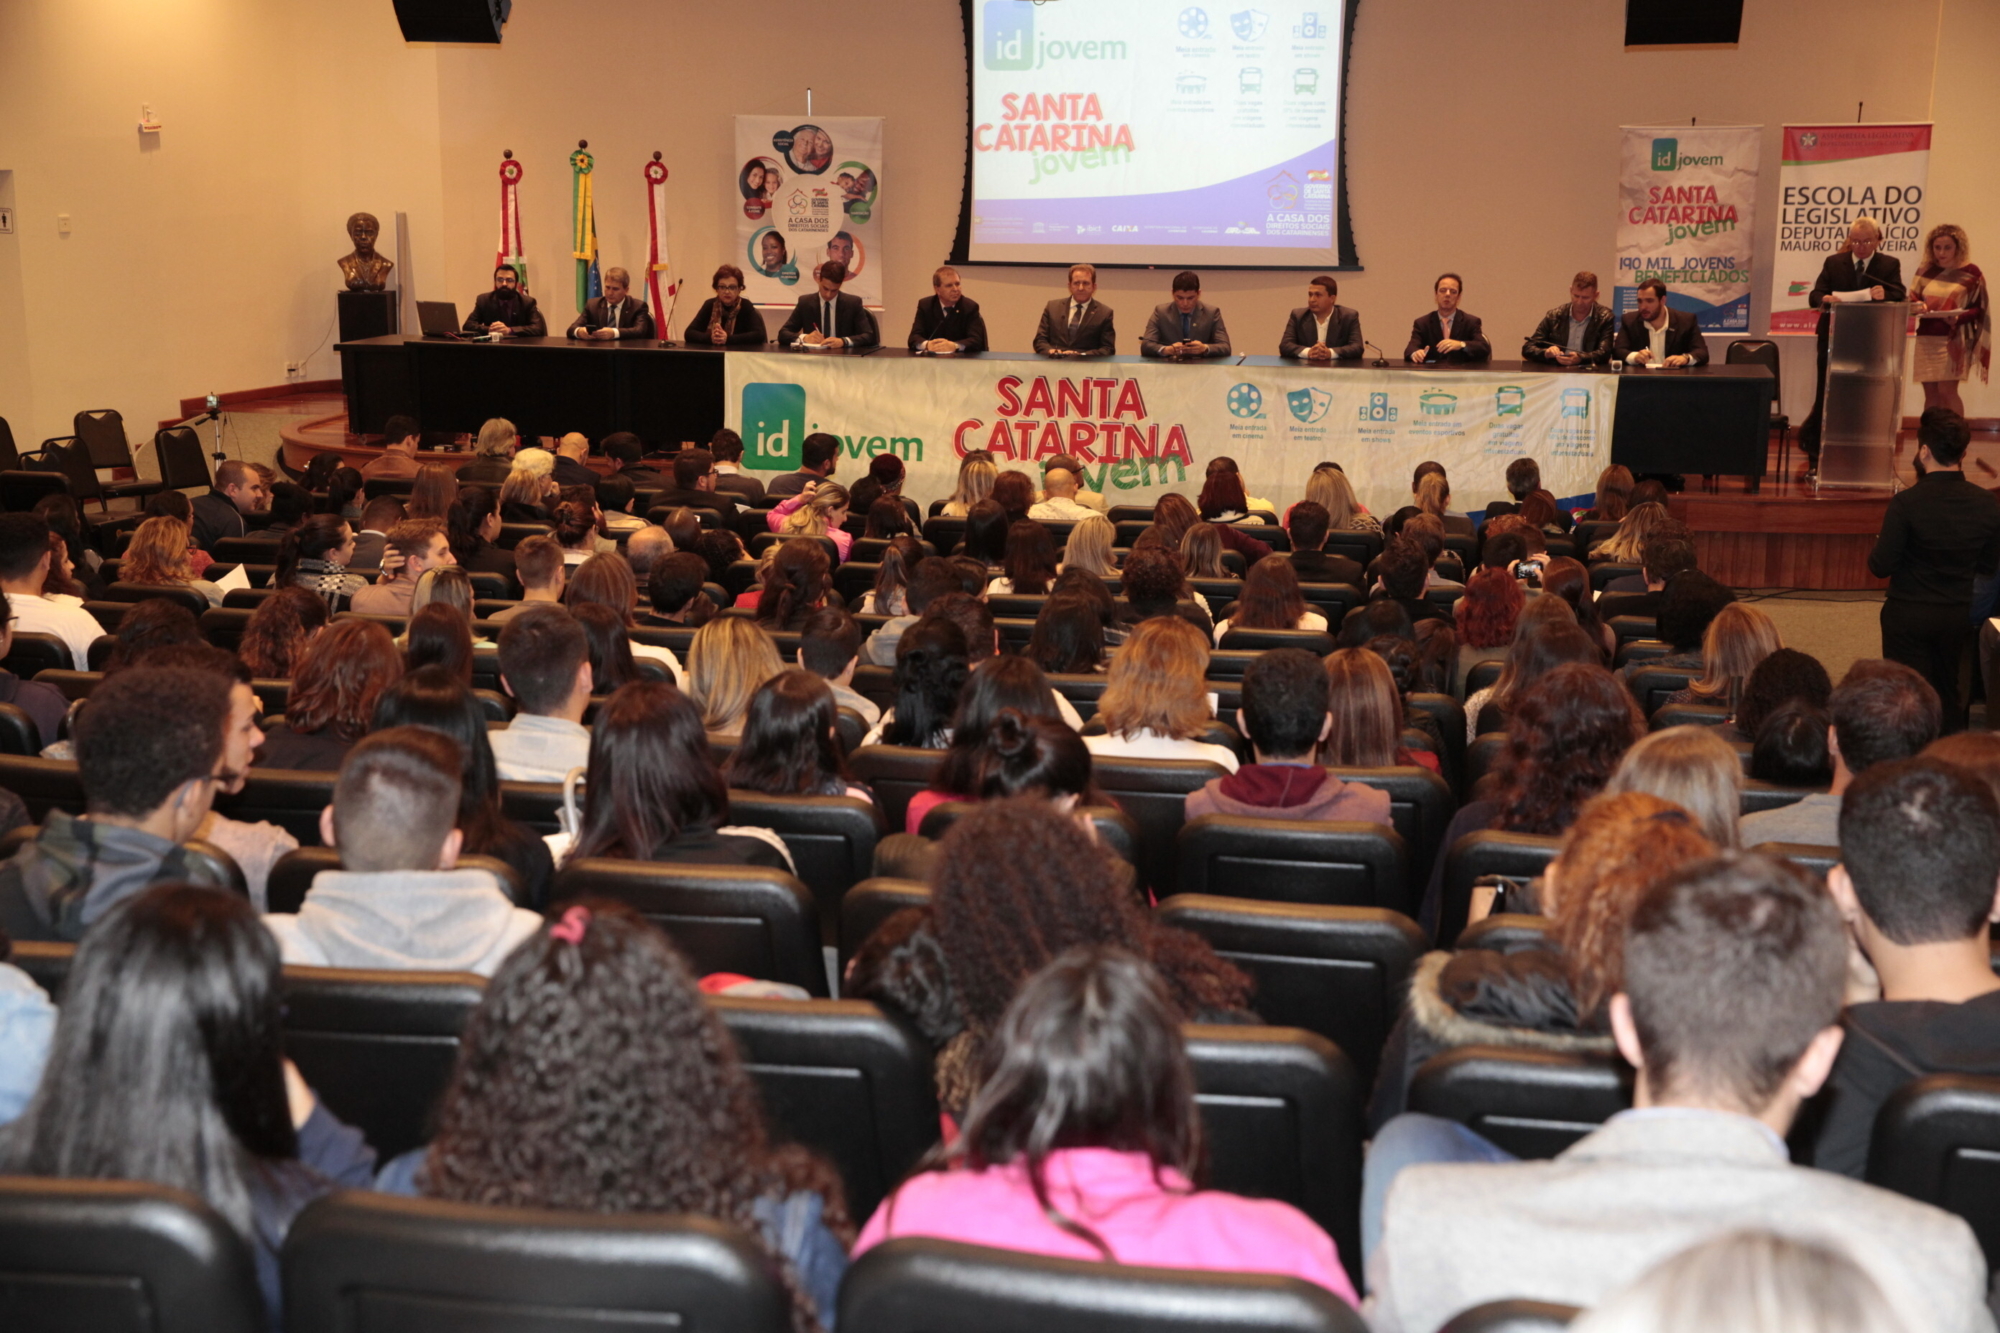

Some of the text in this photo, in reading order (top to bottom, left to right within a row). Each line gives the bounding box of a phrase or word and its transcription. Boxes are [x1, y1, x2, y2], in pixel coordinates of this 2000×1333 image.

[996, 29, 1126, 70] id jovem
[1001, 92, 1104, 122] SANTA
[974, 122, 1136, 152] CATARINA
[1028, 143, 1132, 185] jovem
[1657, 151, 1724, 170] id jovem
[1648, 185, 1718, 204] SANTA
[1783, 185, 1922, 205] ESCOLA DO
[1266, 213, 1330, 223] A CASA DOS
[1628, 204, 1739, 225] CATARINA
[1782, 207, 1921, 225] LEGISLATIVO
[1665, 218, 1736, 246] jovem
[1781, 224, 1920, 240] DEPUTA ÍCIO
[1780, 241, 1832, 252] MAURO
[1878, 241, 1917, 251] VEIRA
[1619, 256, 1736, 270] 190 MIL JOVENS
[1634, 270, 1750, 283] BENEFICIADOS
[995, 375, 1148, 422] SANTA
[757, 420, 790, 457] id
[953, 418, 1194, 467] CATARINA
